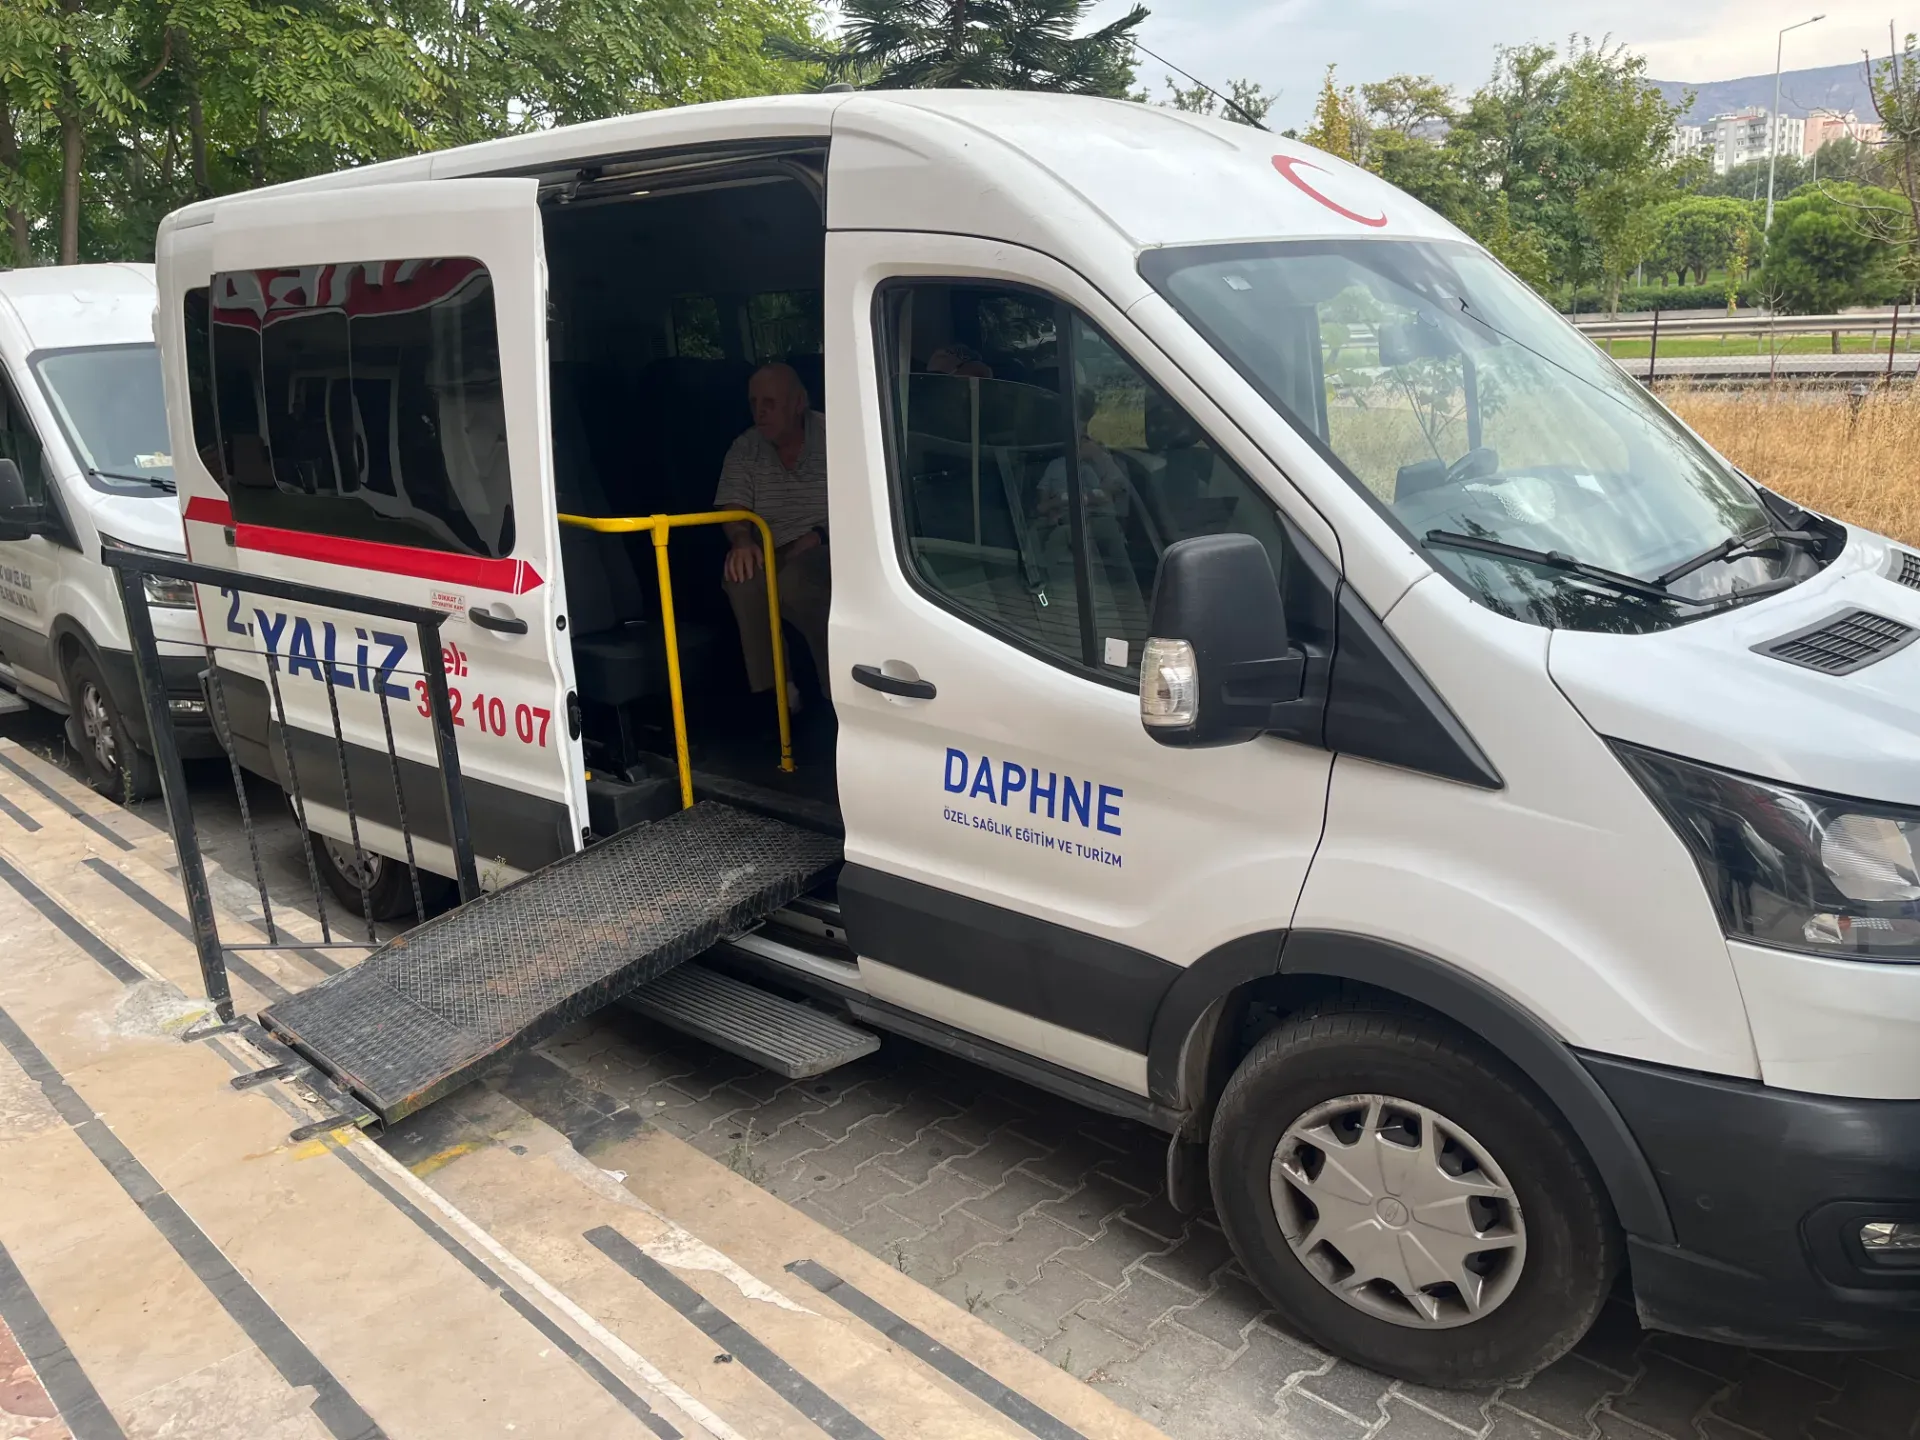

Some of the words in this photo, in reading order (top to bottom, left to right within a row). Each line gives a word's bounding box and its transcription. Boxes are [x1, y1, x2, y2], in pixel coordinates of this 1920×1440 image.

[441, 641, 468, 677] el:
[414, 680, 465, 727] 32
[472, 693, 507, 737] 10
[515, 703, 551, 748] 07
[944, 747, 1124, 836] DAPHNE
[943, 805, 971, 826] ÖZEL
[972, 816, 1013, 838] SAĞLIK
[1057, 839, 1072, 854] VE
